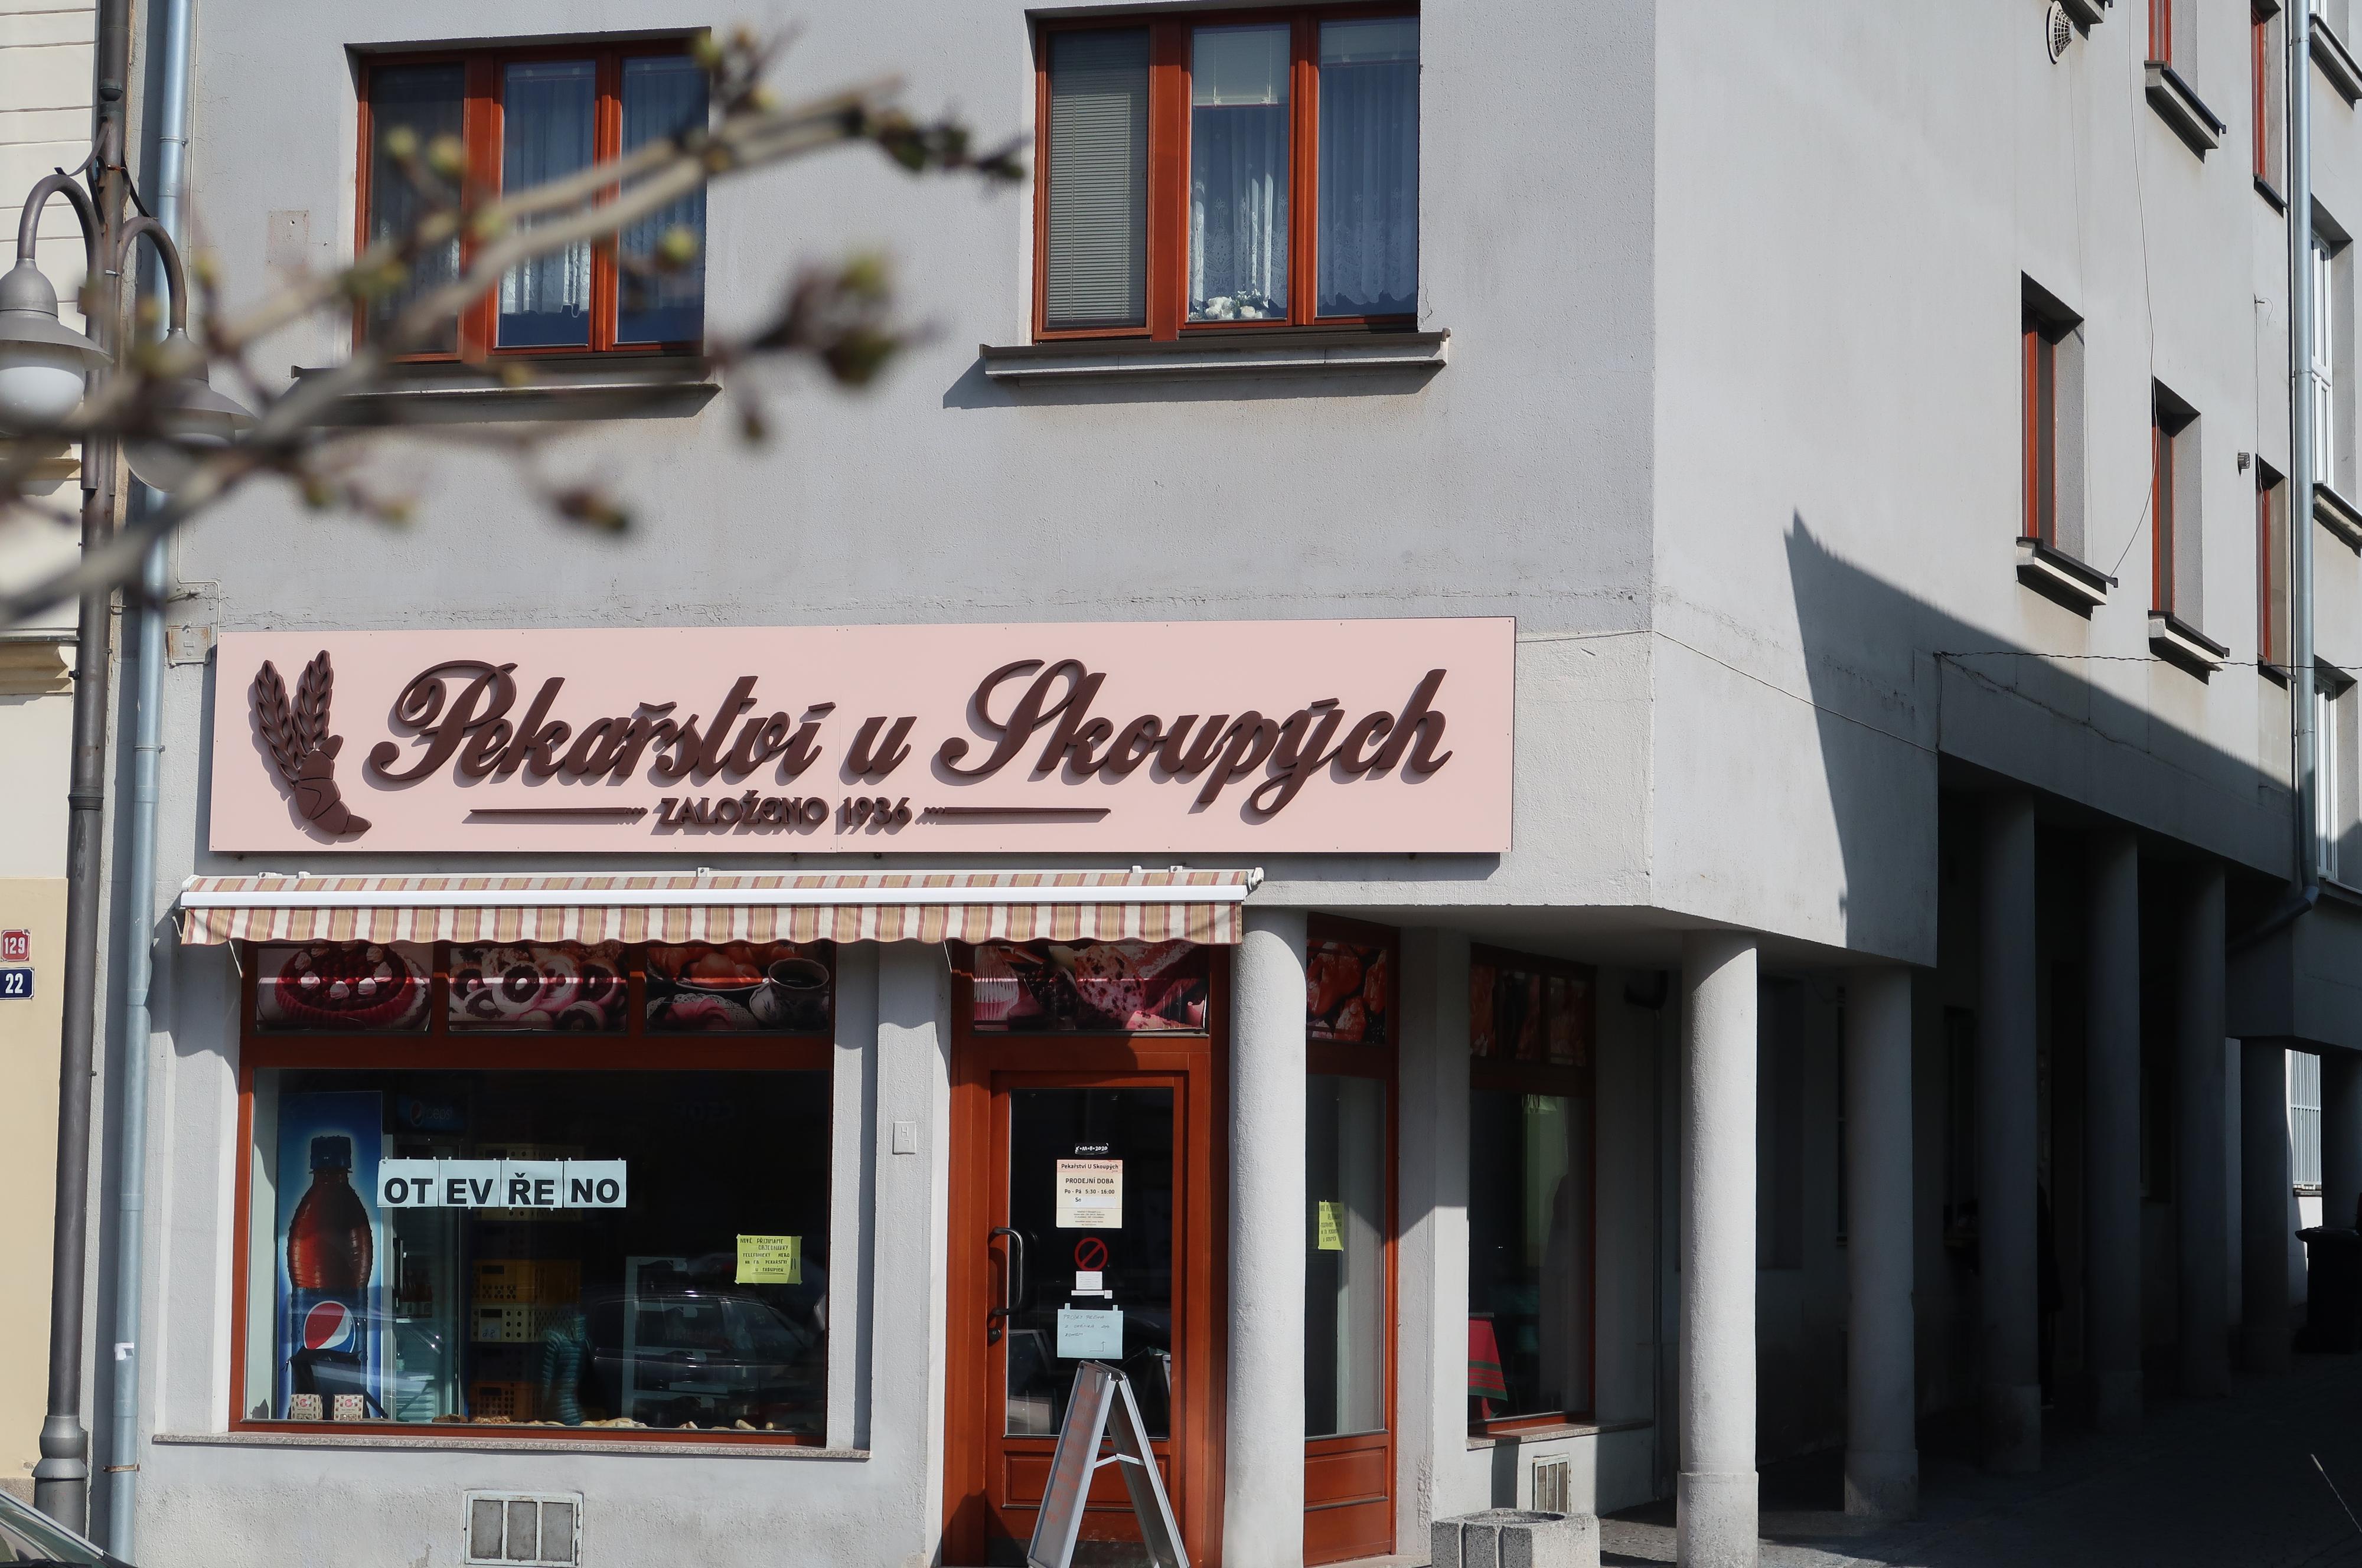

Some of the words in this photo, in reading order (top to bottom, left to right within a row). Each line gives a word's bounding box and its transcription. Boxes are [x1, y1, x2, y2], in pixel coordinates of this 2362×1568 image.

[369, 659, 837, 780] Pekařství
[847, 716, 917, 776] u
[939, 659, 1453, 815] Skoupých
[660, 790, 830, 825] ZALOŽENO
[843, 796, 912, 824] 1936
[5, 937, 25, 954] 129
[5, 973, 24, 994] 22
